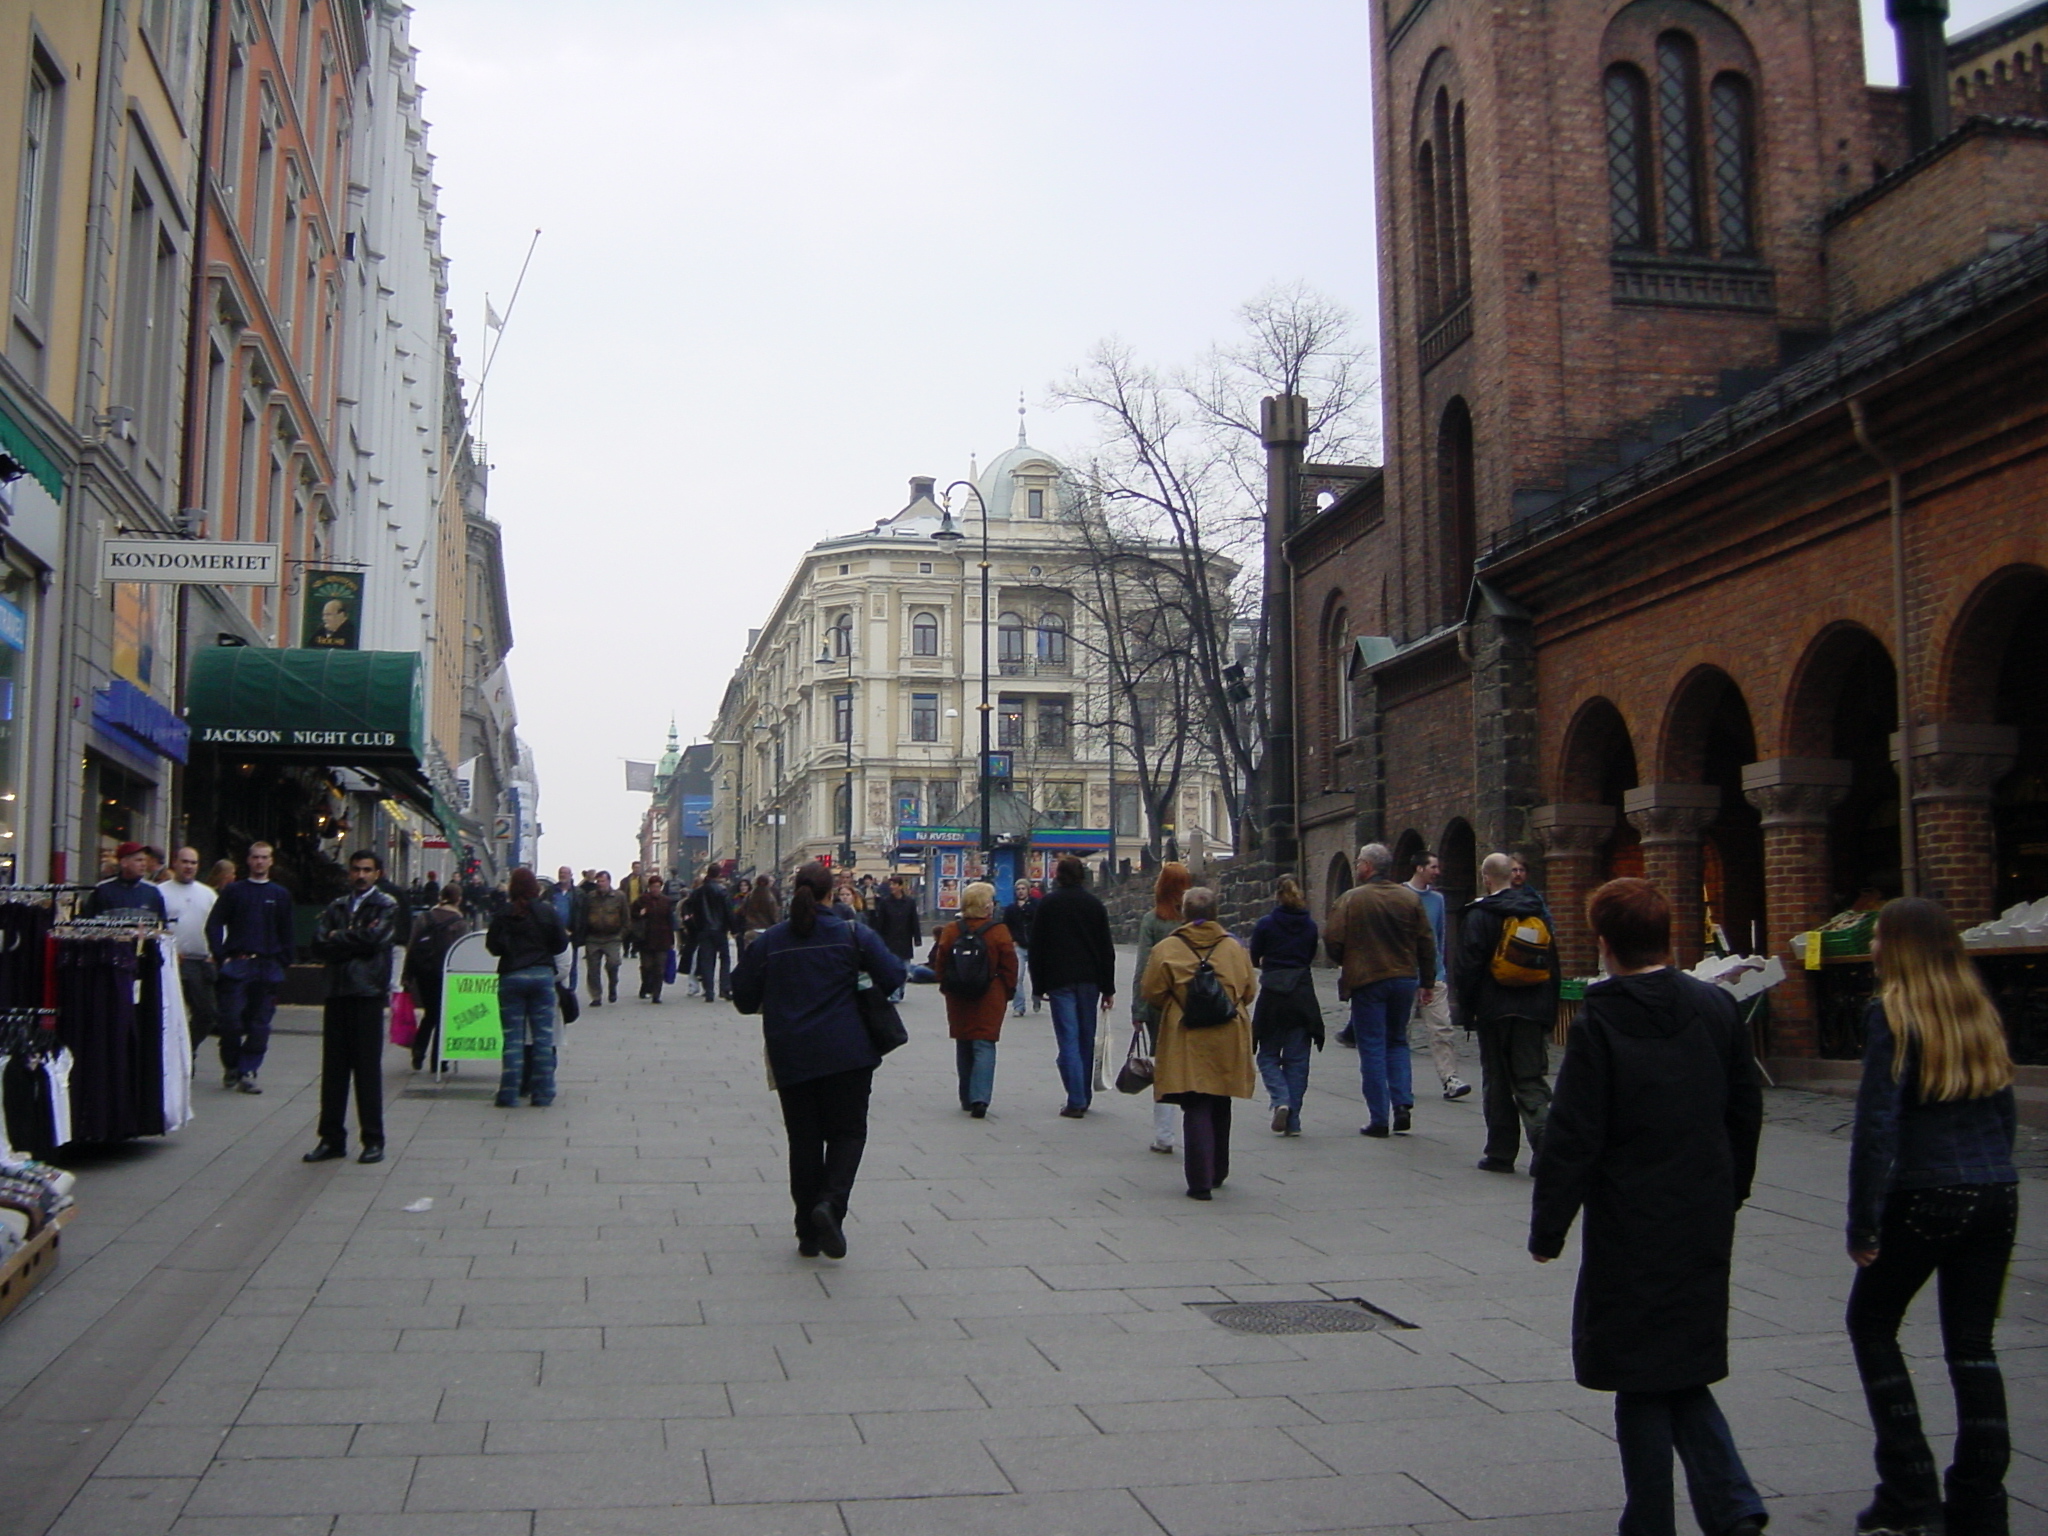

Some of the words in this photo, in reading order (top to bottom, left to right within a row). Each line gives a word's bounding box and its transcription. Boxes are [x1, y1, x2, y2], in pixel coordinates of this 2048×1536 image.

[111, 551, 271, 571] KONDOMERIET
[202, 727, 282, 743] JACKSON
[293, 730, 348, 745] NIGHT
[351, 732, 396, 746] CLUB
